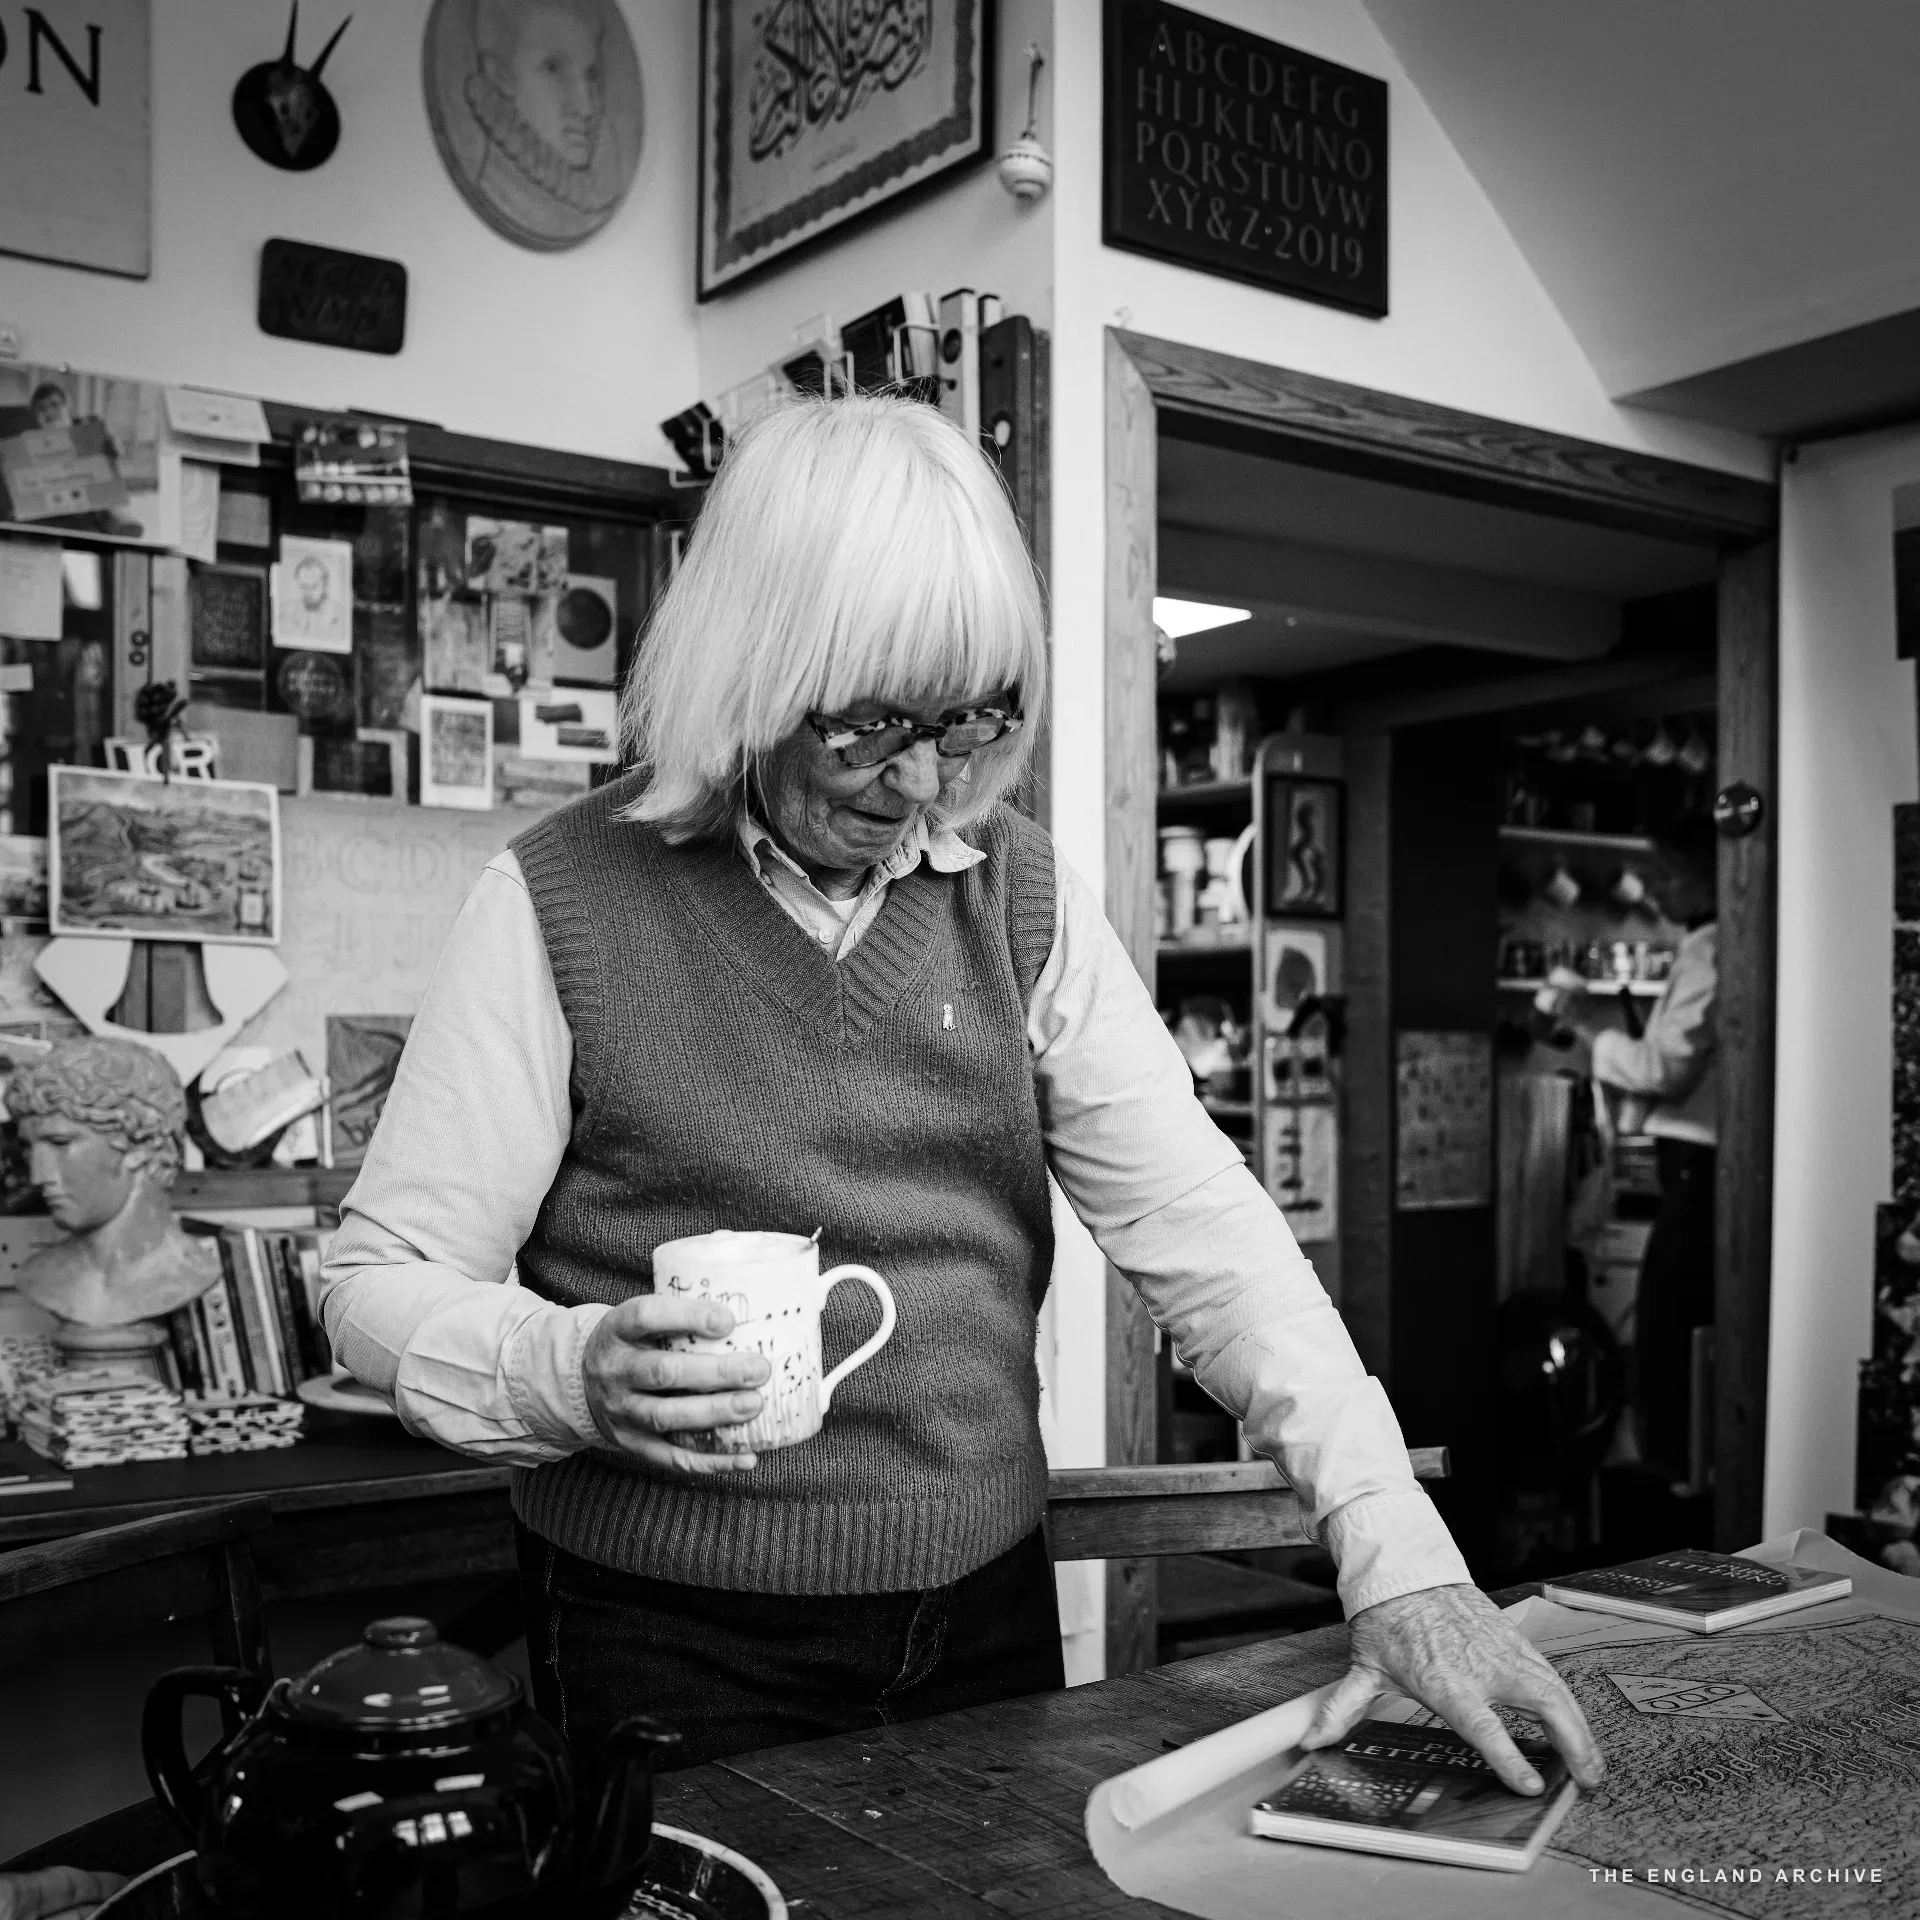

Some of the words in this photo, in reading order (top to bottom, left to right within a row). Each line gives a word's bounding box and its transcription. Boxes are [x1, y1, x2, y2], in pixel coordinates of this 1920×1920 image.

[0, 8, 103, 107] N
[1150, 21, 1360, 129] ABCDEFG
[1136, 67, 1374, 181] HIJKLMNO
[1136, 120, 1372, 230] PQRSTUVW
[1344, 1742, 1541, 1771] LETTERI
[1661, 1748, 1761, 1795] place
[1753, 1736, 1826, 1763] this
[1808, 1726, 1853, 1746] of
